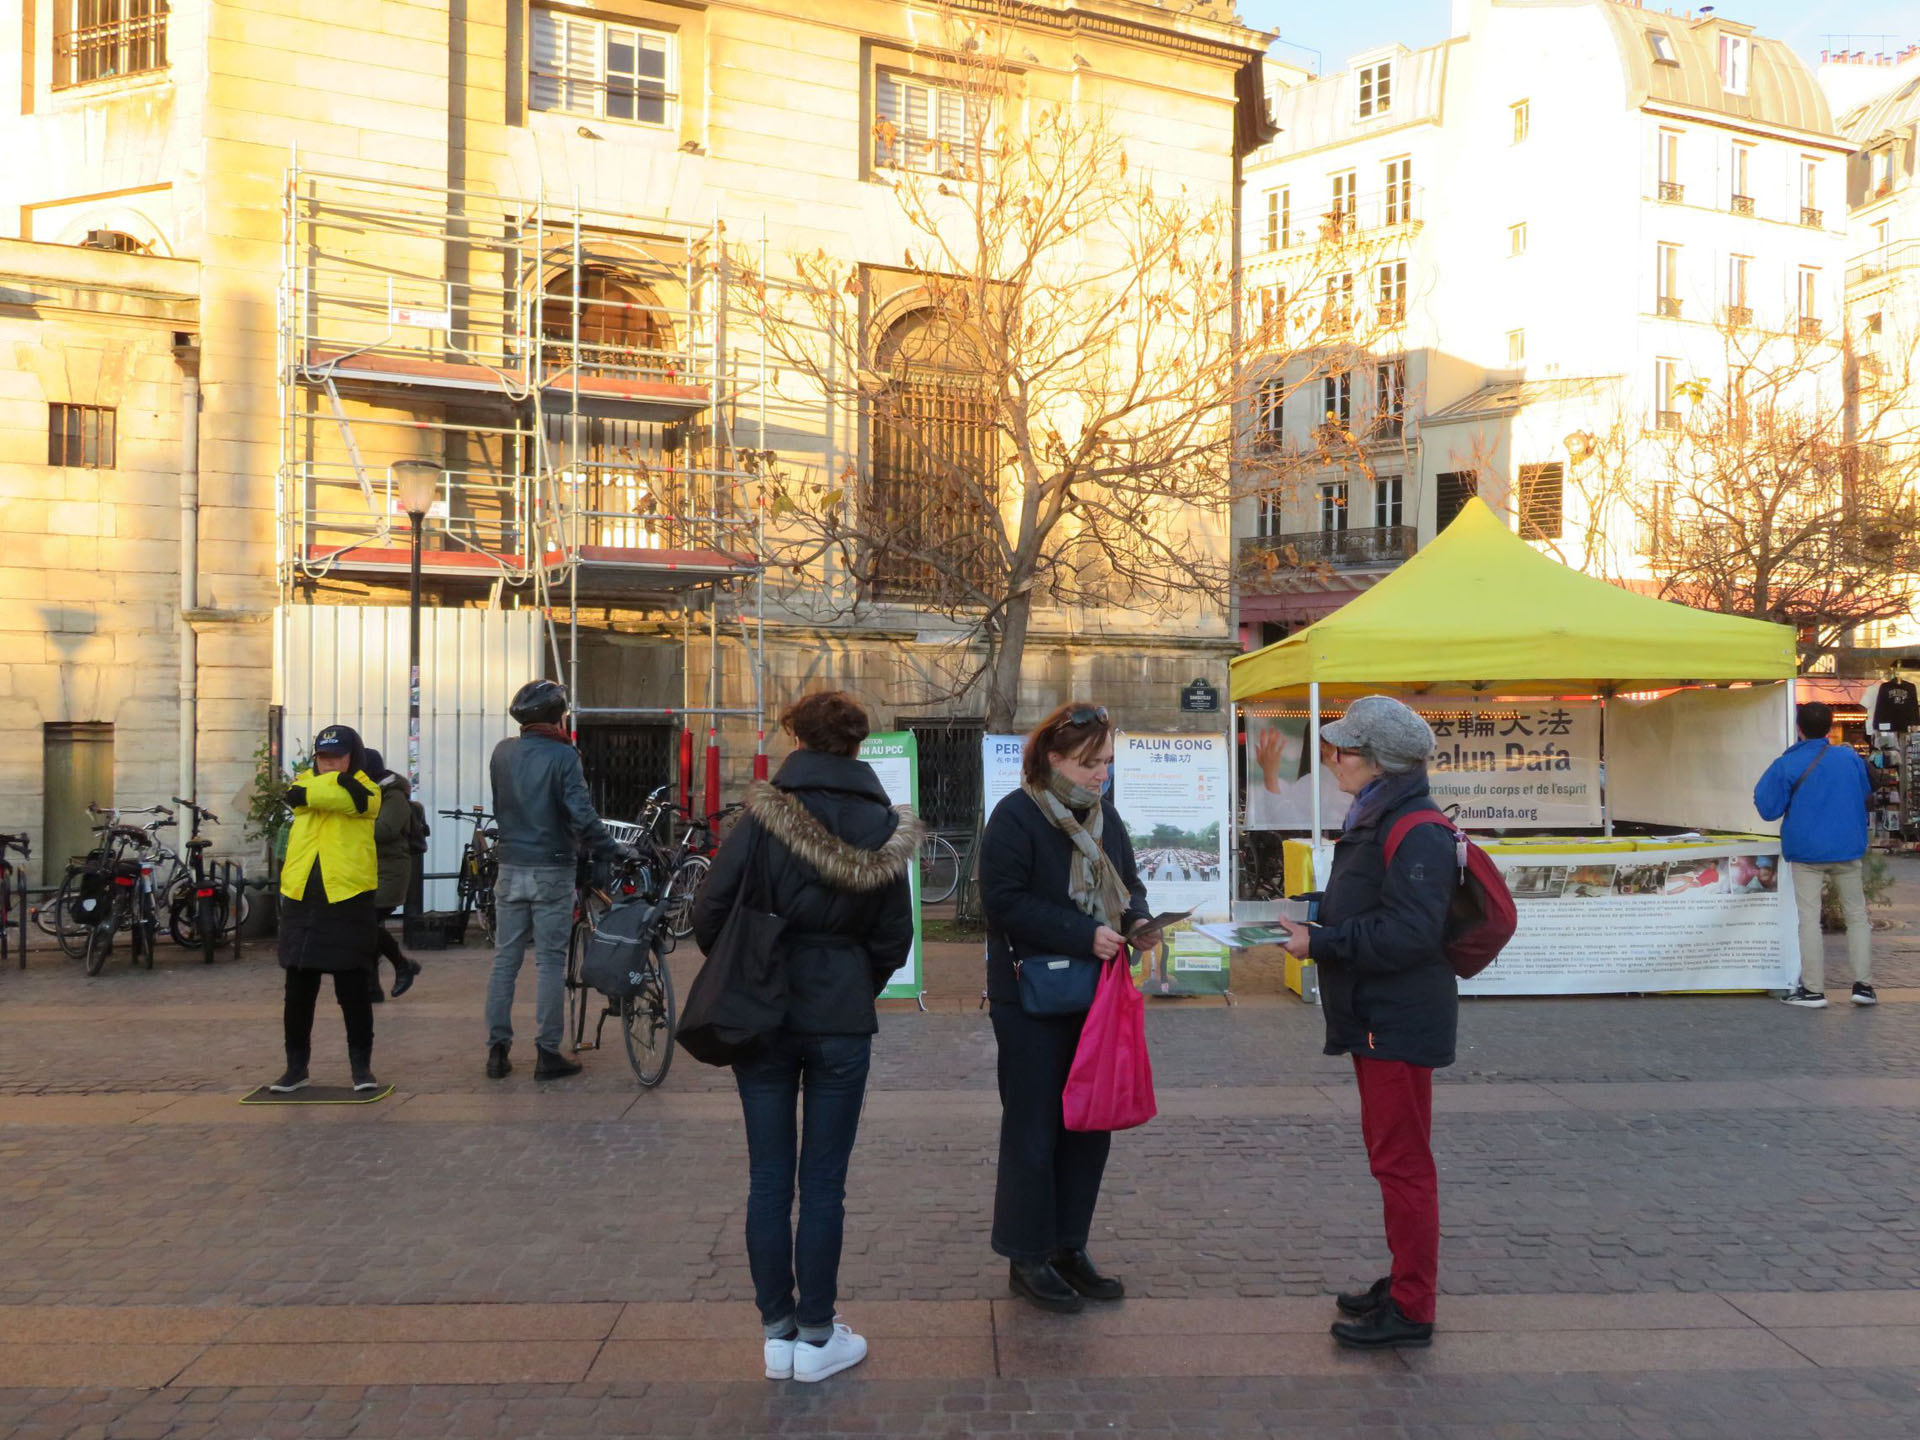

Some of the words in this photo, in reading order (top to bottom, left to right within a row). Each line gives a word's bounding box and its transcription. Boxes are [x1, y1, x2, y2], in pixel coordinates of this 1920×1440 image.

[871, 746, 883, 755] AU
[886, 745, 903, 754] PCC
[1129, 739, 1171, 750] FALUN
[1174, 739, 1212, 750] GONG
[1431, 743, 1495, 773] alun
[1505, 742, 1571, 772] Dafa
[1473, 783, 1487, 795] du
[1490, 786, 1520, 797] corps
[1523, 784, 1534, 795] et
[1536, 783, 1549, 795] de
[1455, 806, 1538, 821] FalunDafa.org
